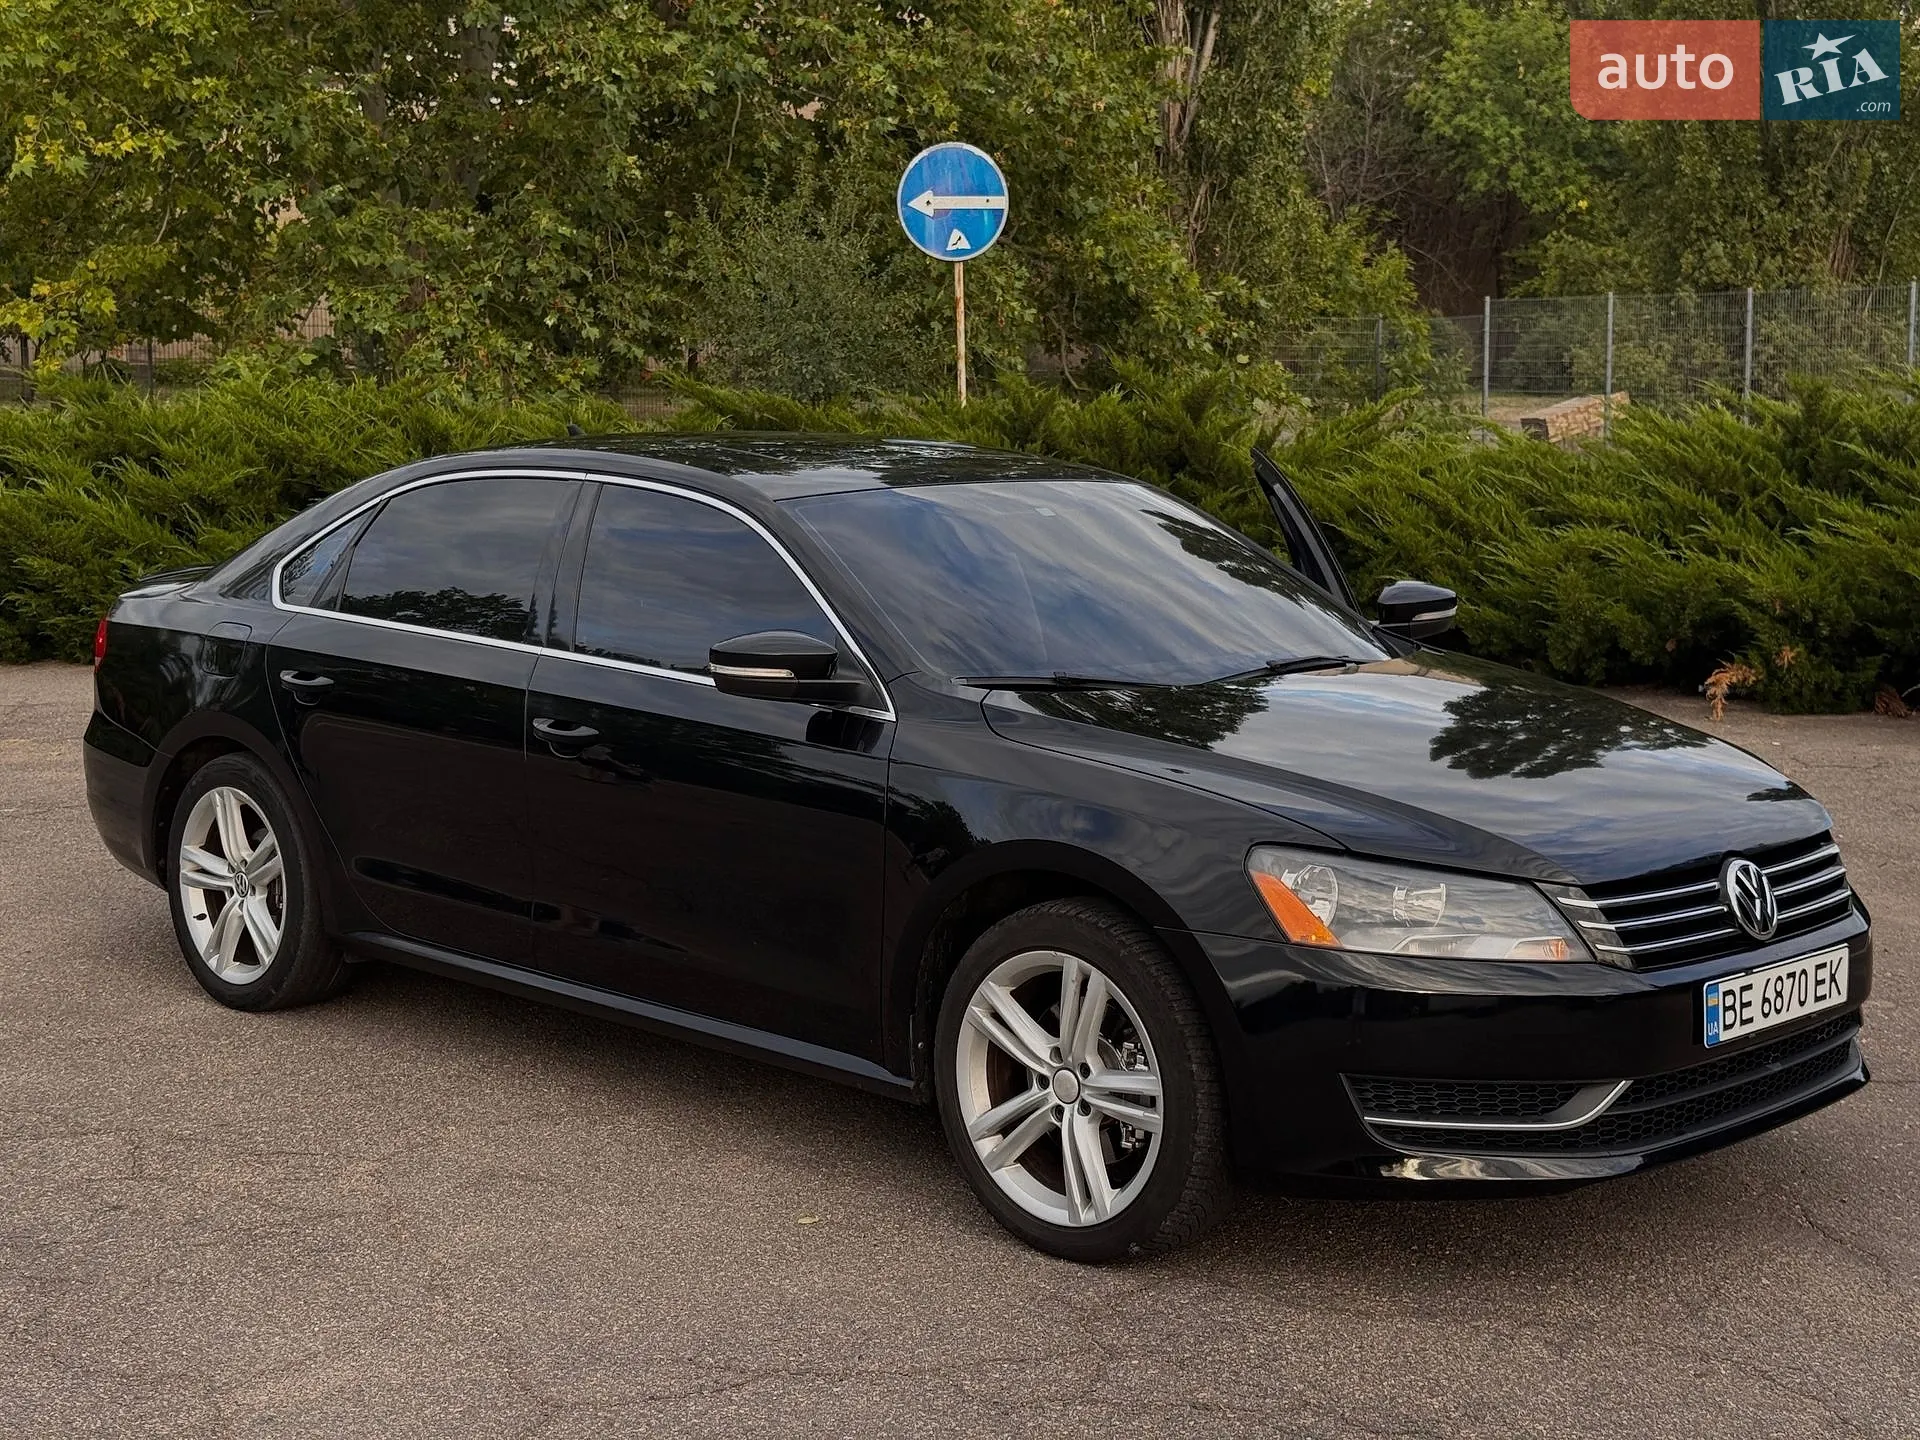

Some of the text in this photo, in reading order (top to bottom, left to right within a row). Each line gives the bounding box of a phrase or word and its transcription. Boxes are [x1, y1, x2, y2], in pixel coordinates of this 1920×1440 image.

[1722, 957, 1844, 1032] BE 6870 EK
[1708, 1021, 1719, 1036] UA
